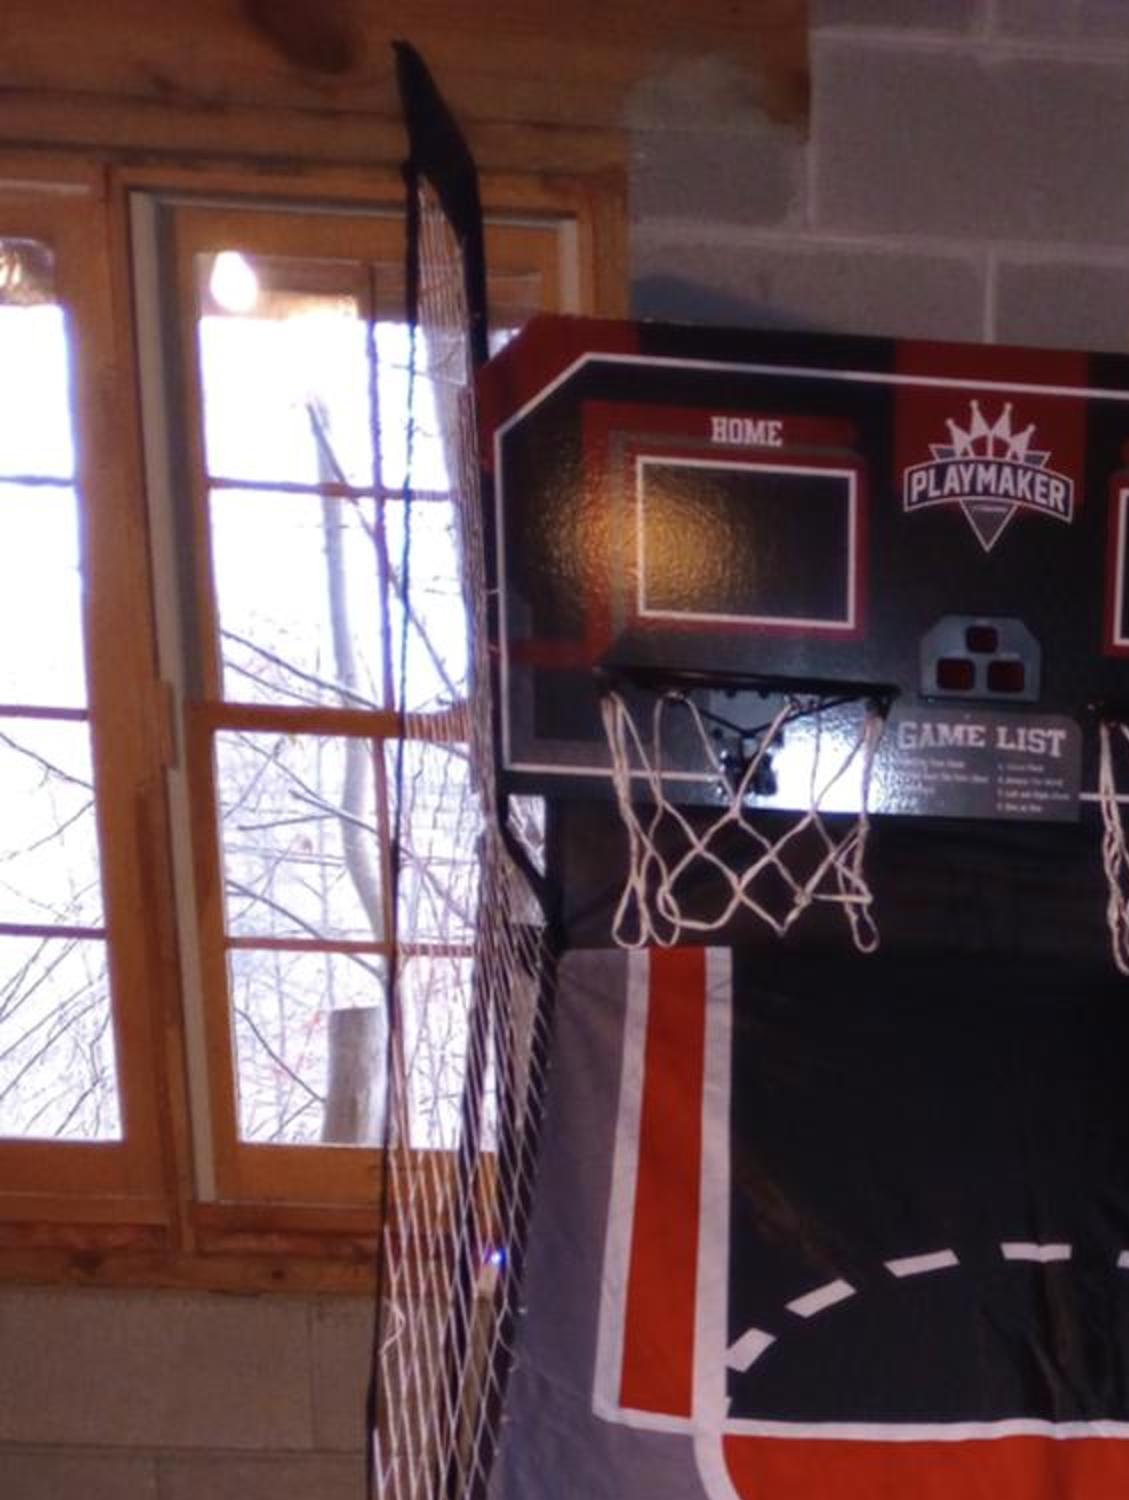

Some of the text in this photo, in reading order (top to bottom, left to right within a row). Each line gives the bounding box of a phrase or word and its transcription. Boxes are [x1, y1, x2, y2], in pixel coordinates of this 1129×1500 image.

[710, 416, 783, 447] HOME
[910, 460, 1066, 510] PLAYMAKER
[899, 720, 1067, 759] GAME LIST
